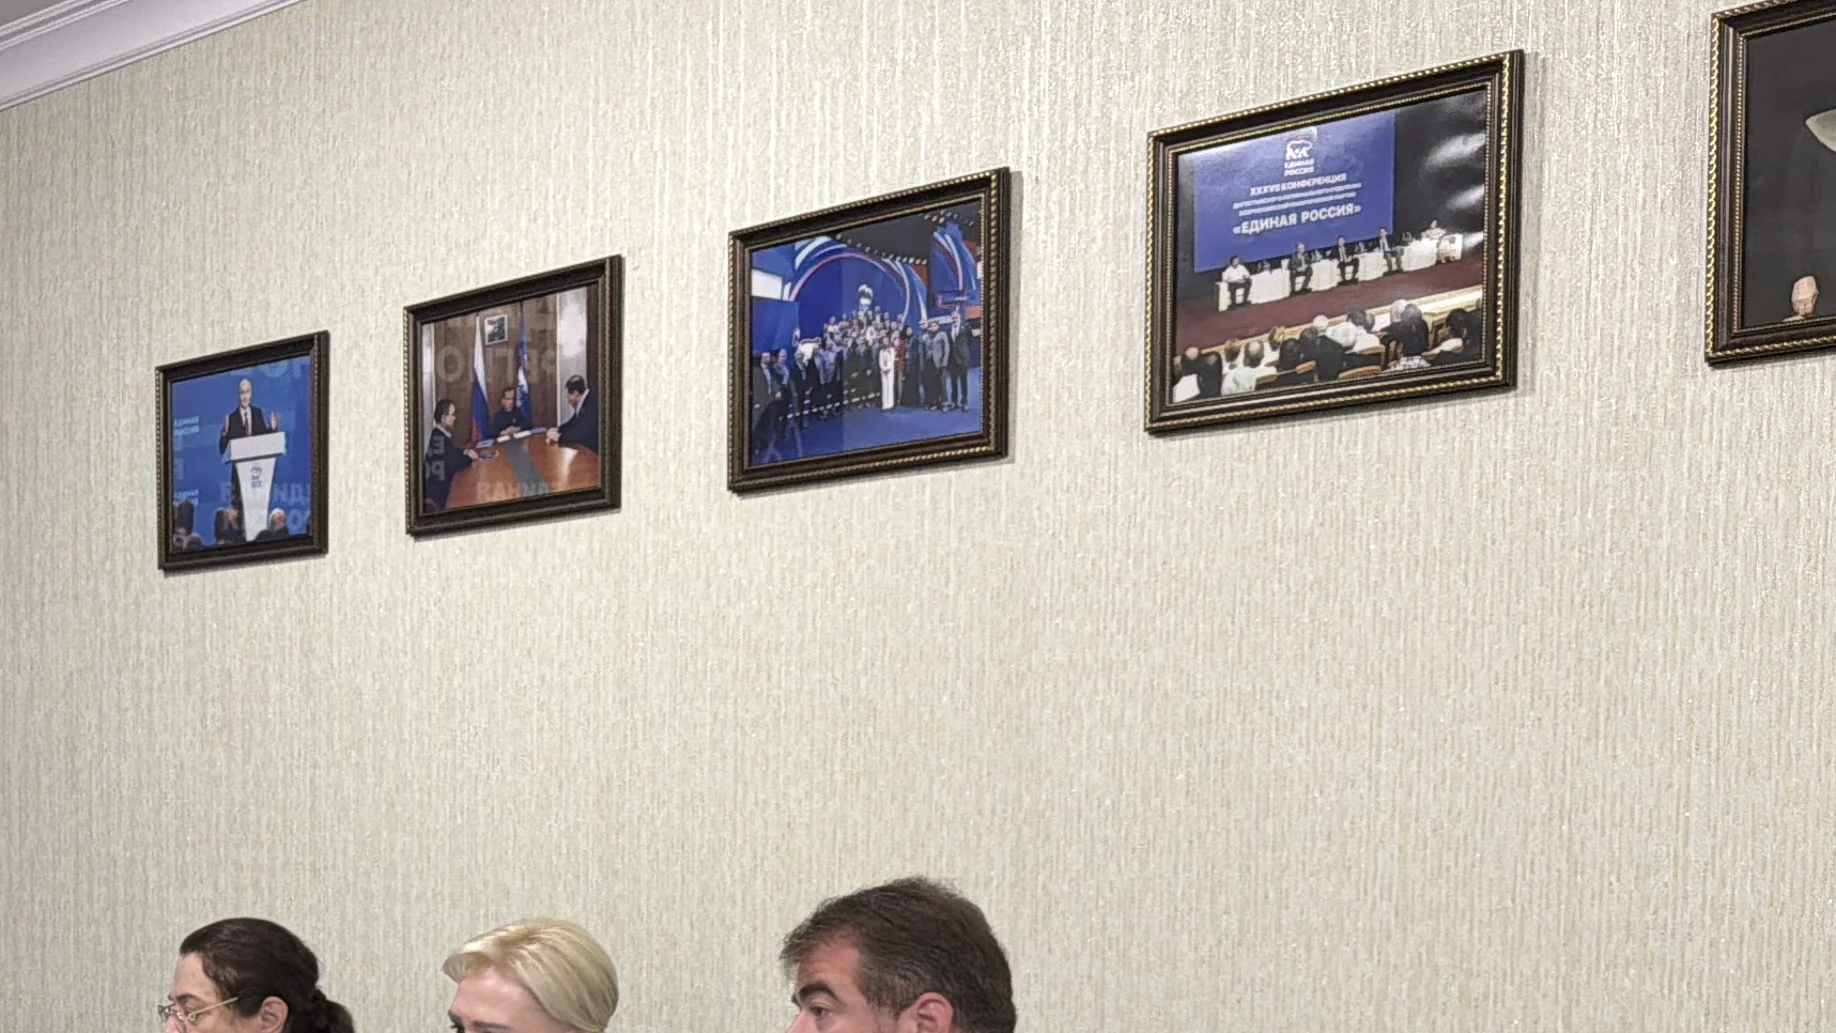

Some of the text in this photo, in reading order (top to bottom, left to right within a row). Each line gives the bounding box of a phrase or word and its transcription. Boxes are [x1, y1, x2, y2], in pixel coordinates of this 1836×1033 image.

[1281, 173, 1347, 192] КОНФЕРЕНЦИЯ
[1232, 212, 1298, 235] «ЕДИНАЯ
[1301, 202, 1362, 224] РОССИЯ»
